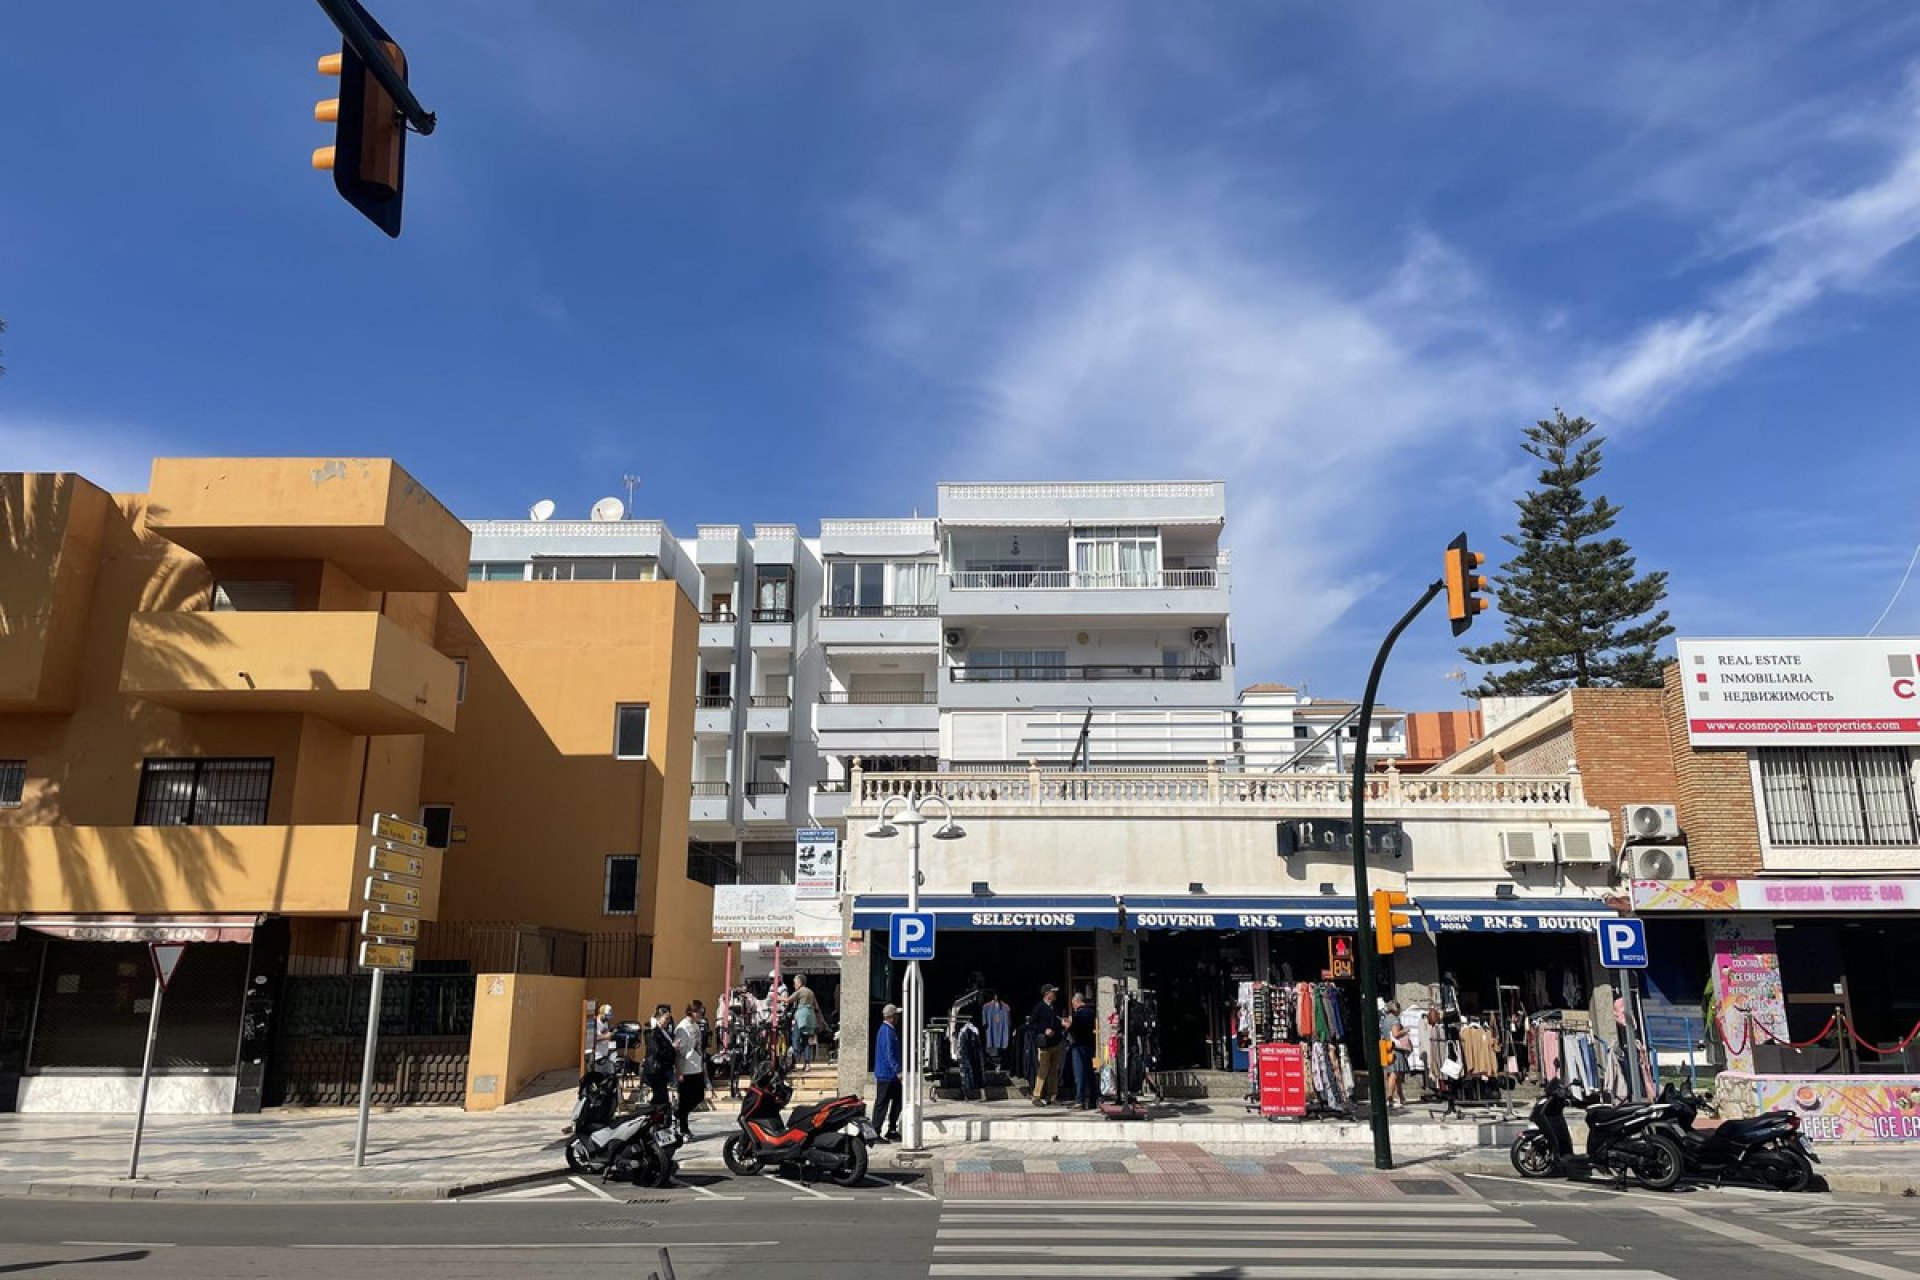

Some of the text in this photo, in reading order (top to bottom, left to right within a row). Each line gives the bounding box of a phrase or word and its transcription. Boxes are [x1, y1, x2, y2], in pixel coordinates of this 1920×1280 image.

[1718, 655, 1801, 666] REAL ESTATE
[1720, 673, 1813, 684] INMOBILIARIA
[1723, 691, 1834, 703] НЕДВИЖИМОСТЬ
[1706, 720, 1900, 733] www.cosmopolitan-properties.com
[1765, 886, 1904, 901] ICE CREAM COFFEE BAR
[972, 914, 1075, 926] SELECTIONS
[1137, 914, 1216, 927] SOUVENIR
[1238, 914, 1282, 927] P.N.S.
[1440, 922, 1468, 930] MODA
[1483, 916, 1528, 929] P.N.S.
[898, 918, 926, 953] P
[1607, 924, 1636, 961] P
[1334, 959, 1351, 977] 84
[1873, 1116, 1900, 1138] ICE
